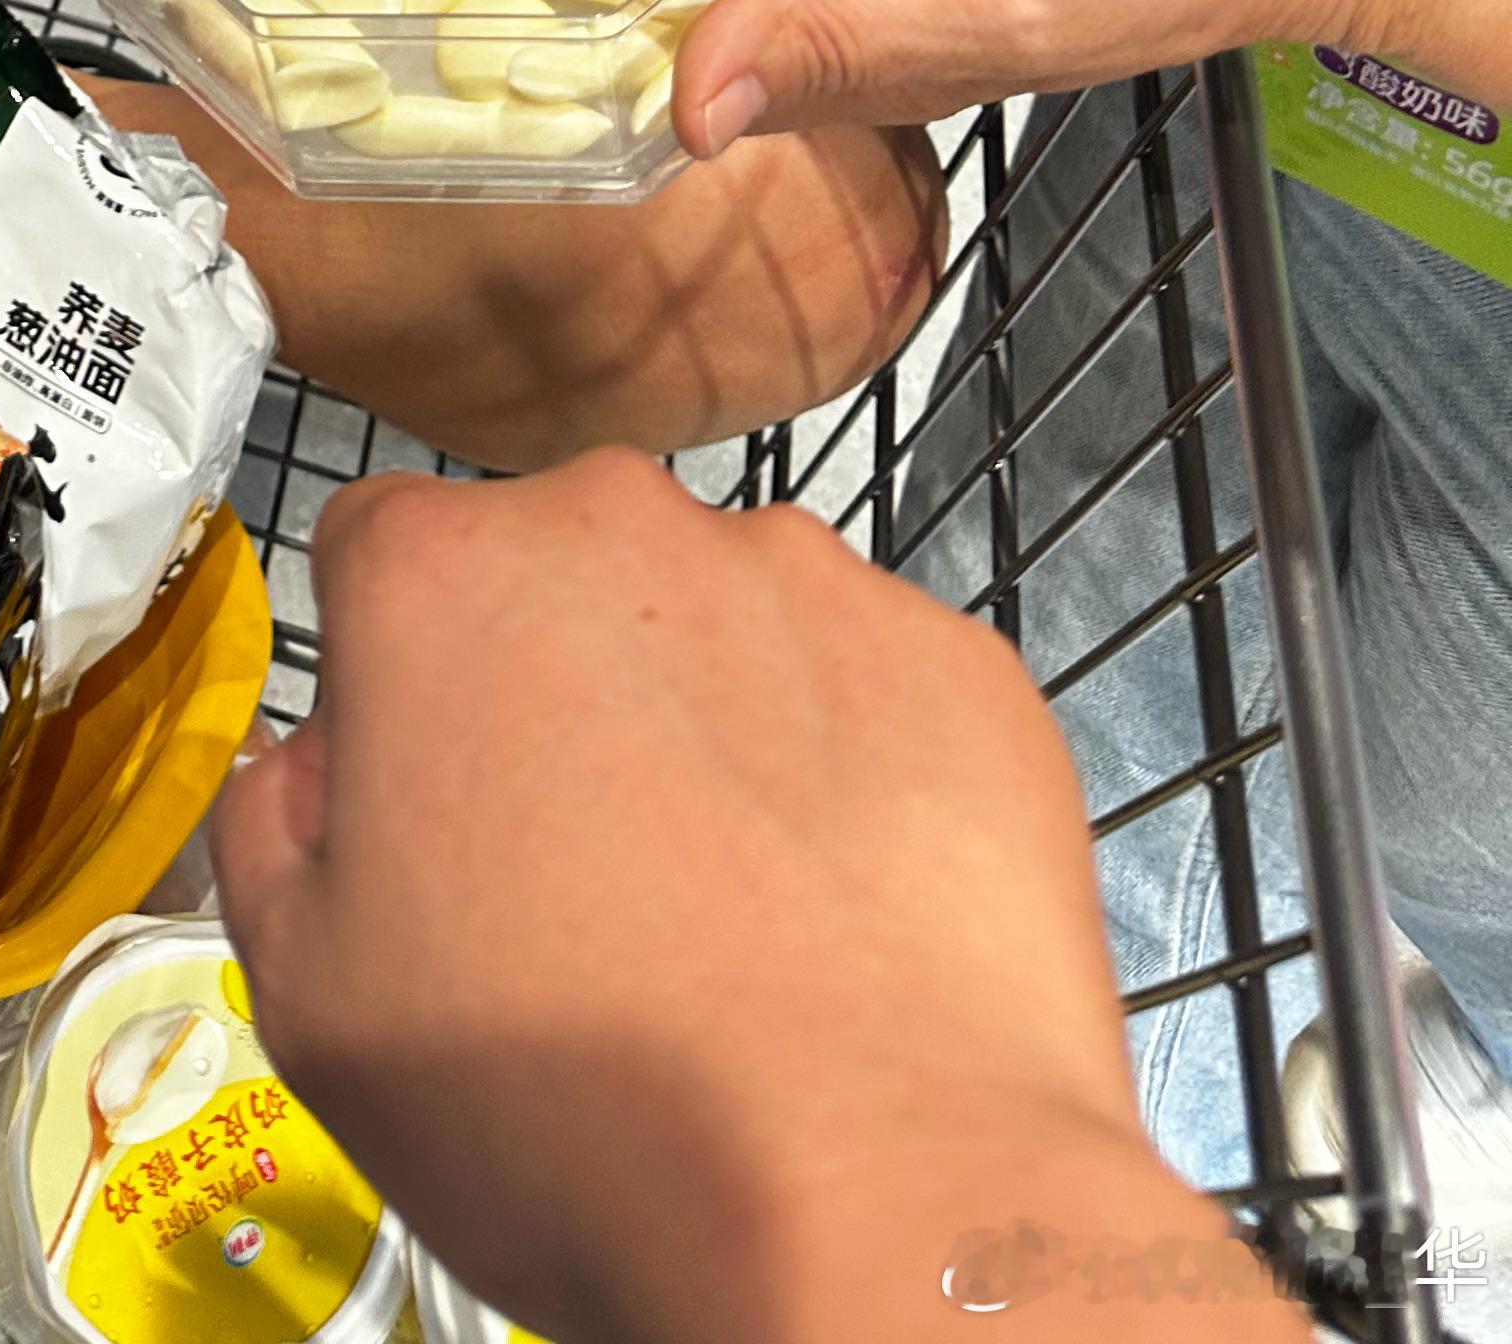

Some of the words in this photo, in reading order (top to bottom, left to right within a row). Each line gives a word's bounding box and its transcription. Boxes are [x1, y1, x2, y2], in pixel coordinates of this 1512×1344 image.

[1359, 57, 1488, 139] 酸奶味
[56, 281, 145, 362] 荞麦
[105, 1088, 288, 1223] 奶皮子酸奶
